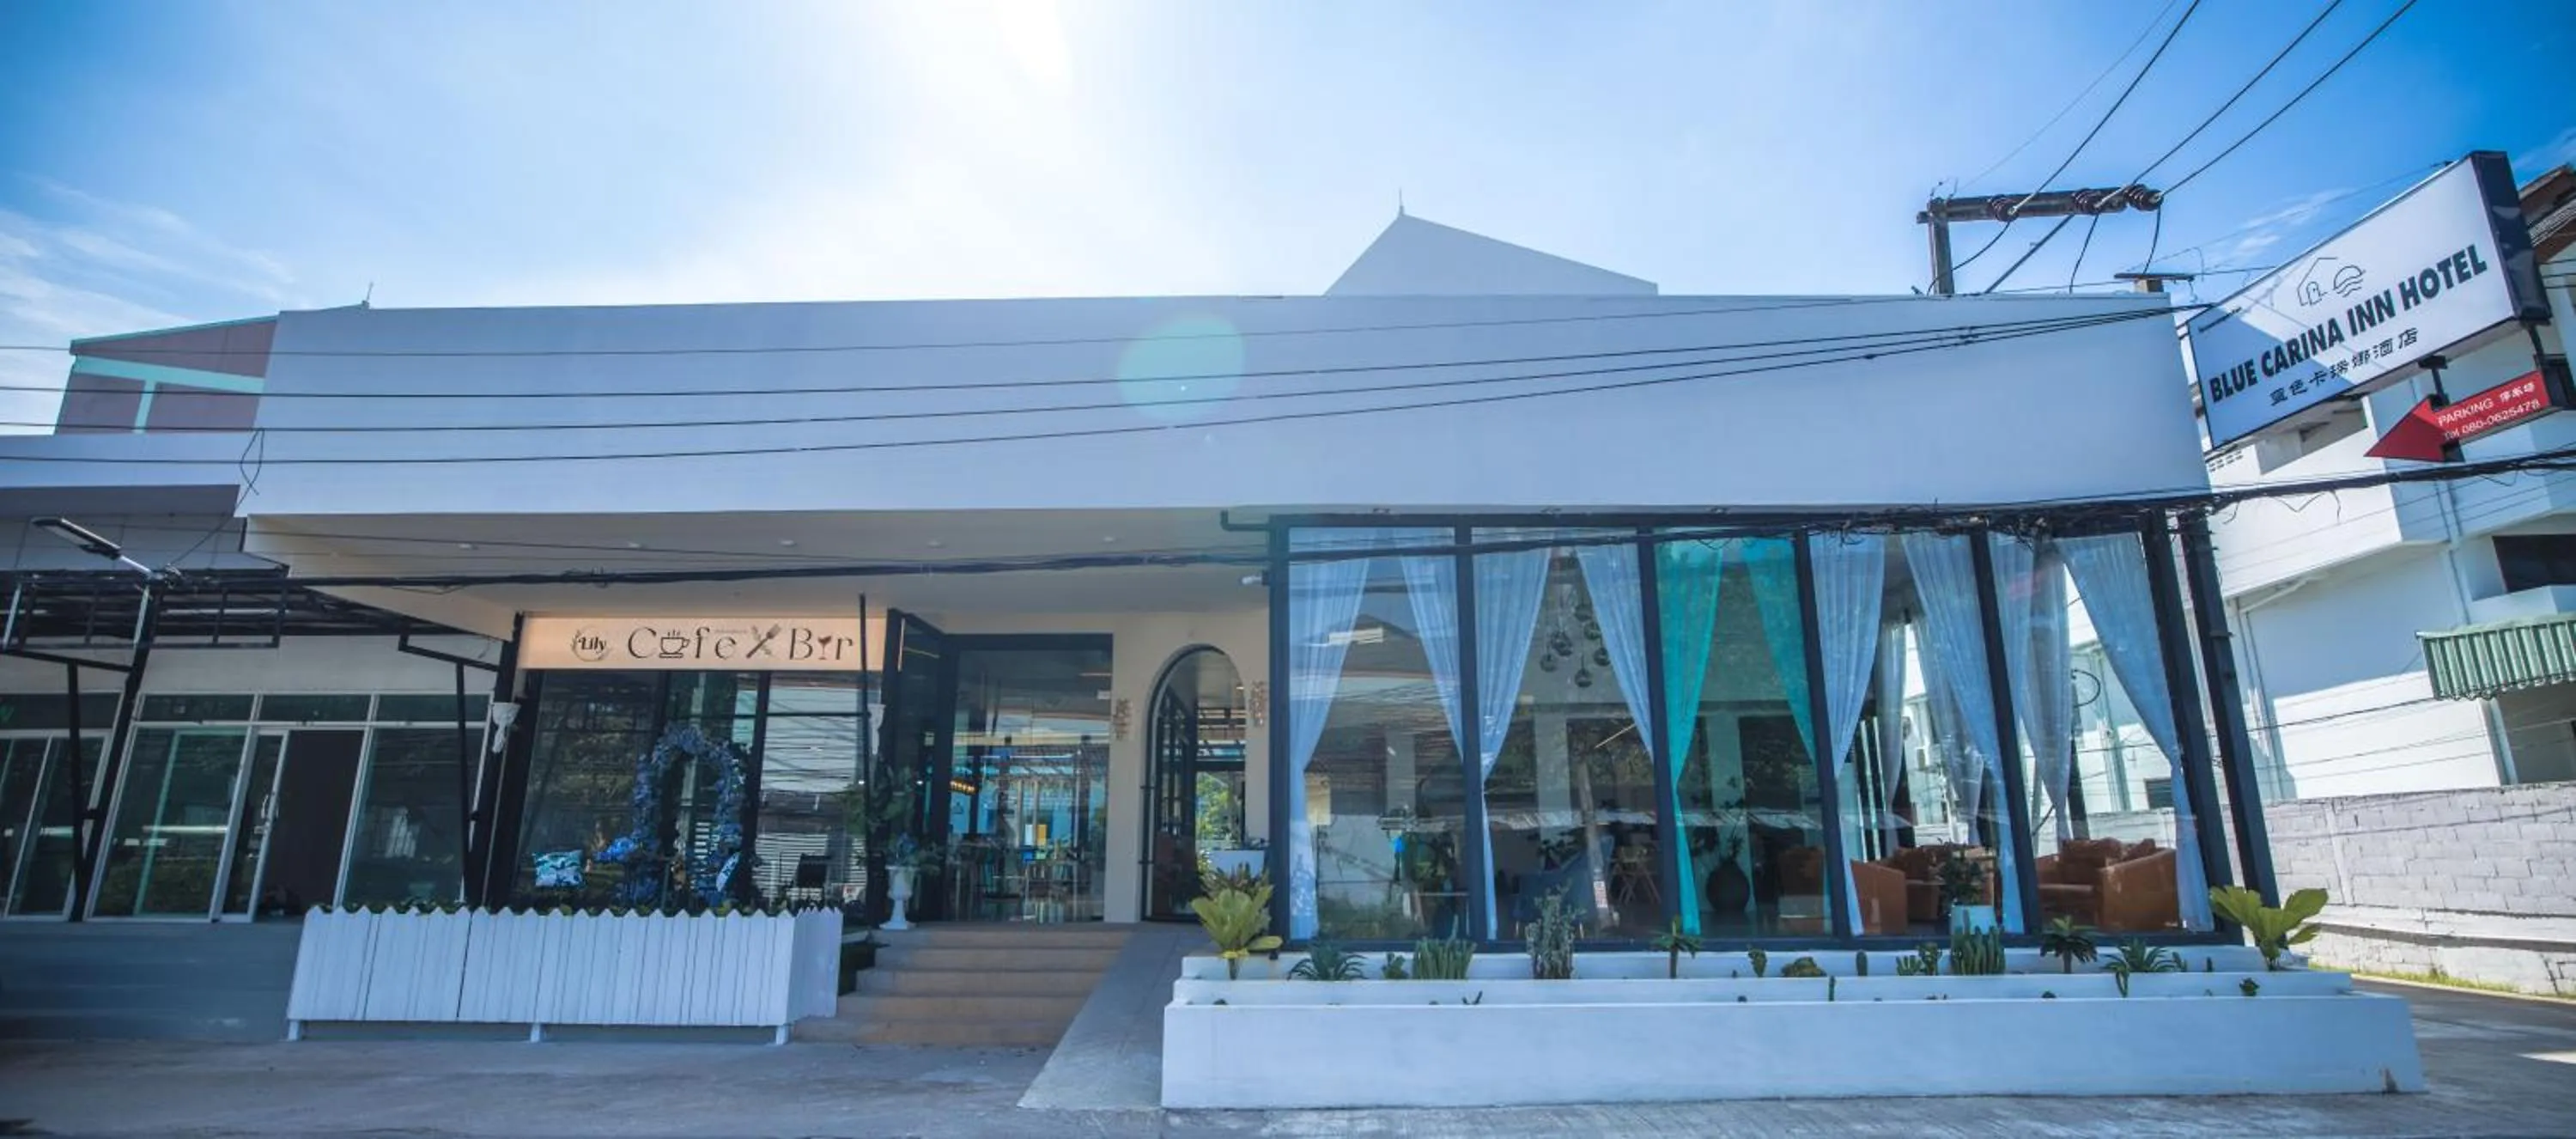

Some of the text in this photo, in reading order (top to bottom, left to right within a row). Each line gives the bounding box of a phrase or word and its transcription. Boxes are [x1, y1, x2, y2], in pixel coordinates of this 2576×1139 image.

[2209, 244, 2488, 403] BLUE CARINA INN HOTEL
[2438, 398, 2494, 426] PARKING
[628, 626, 854, 661] Cfe Br
